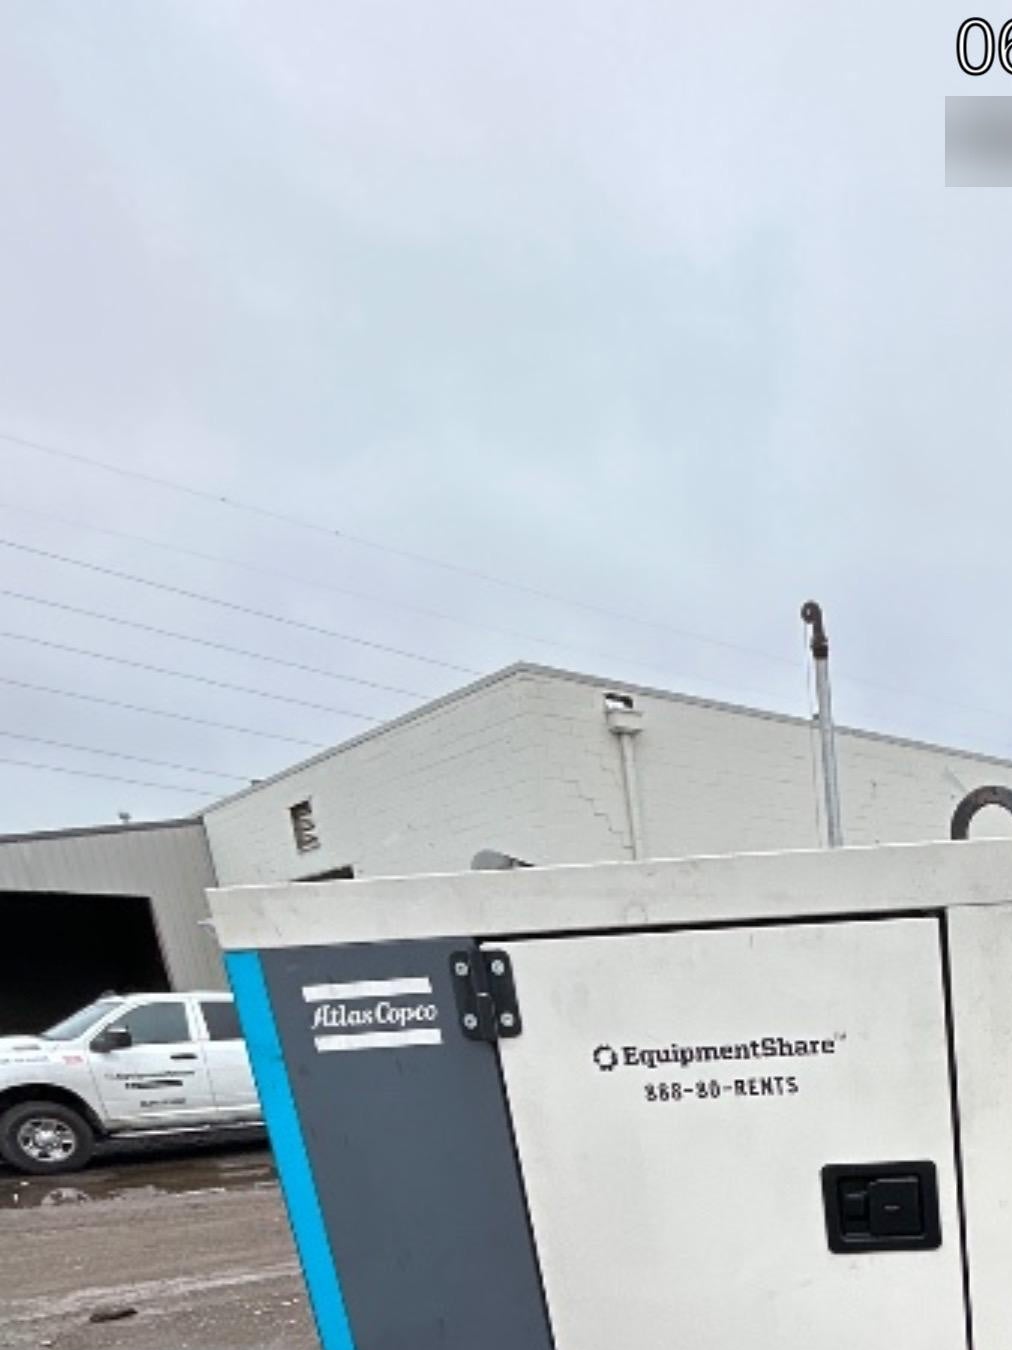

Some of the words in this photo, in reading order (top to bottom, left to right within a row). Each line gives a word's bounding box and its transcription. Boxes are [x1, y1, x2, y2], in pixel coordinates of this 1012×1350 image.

[311, 1003, 374, 1030] Atlas
[375, 1001, 439, 1027] Copco
[621, 1037, 836, 1069] EquipmentShare
[643, 1076, 800, 1102] 888-80-RENTS
